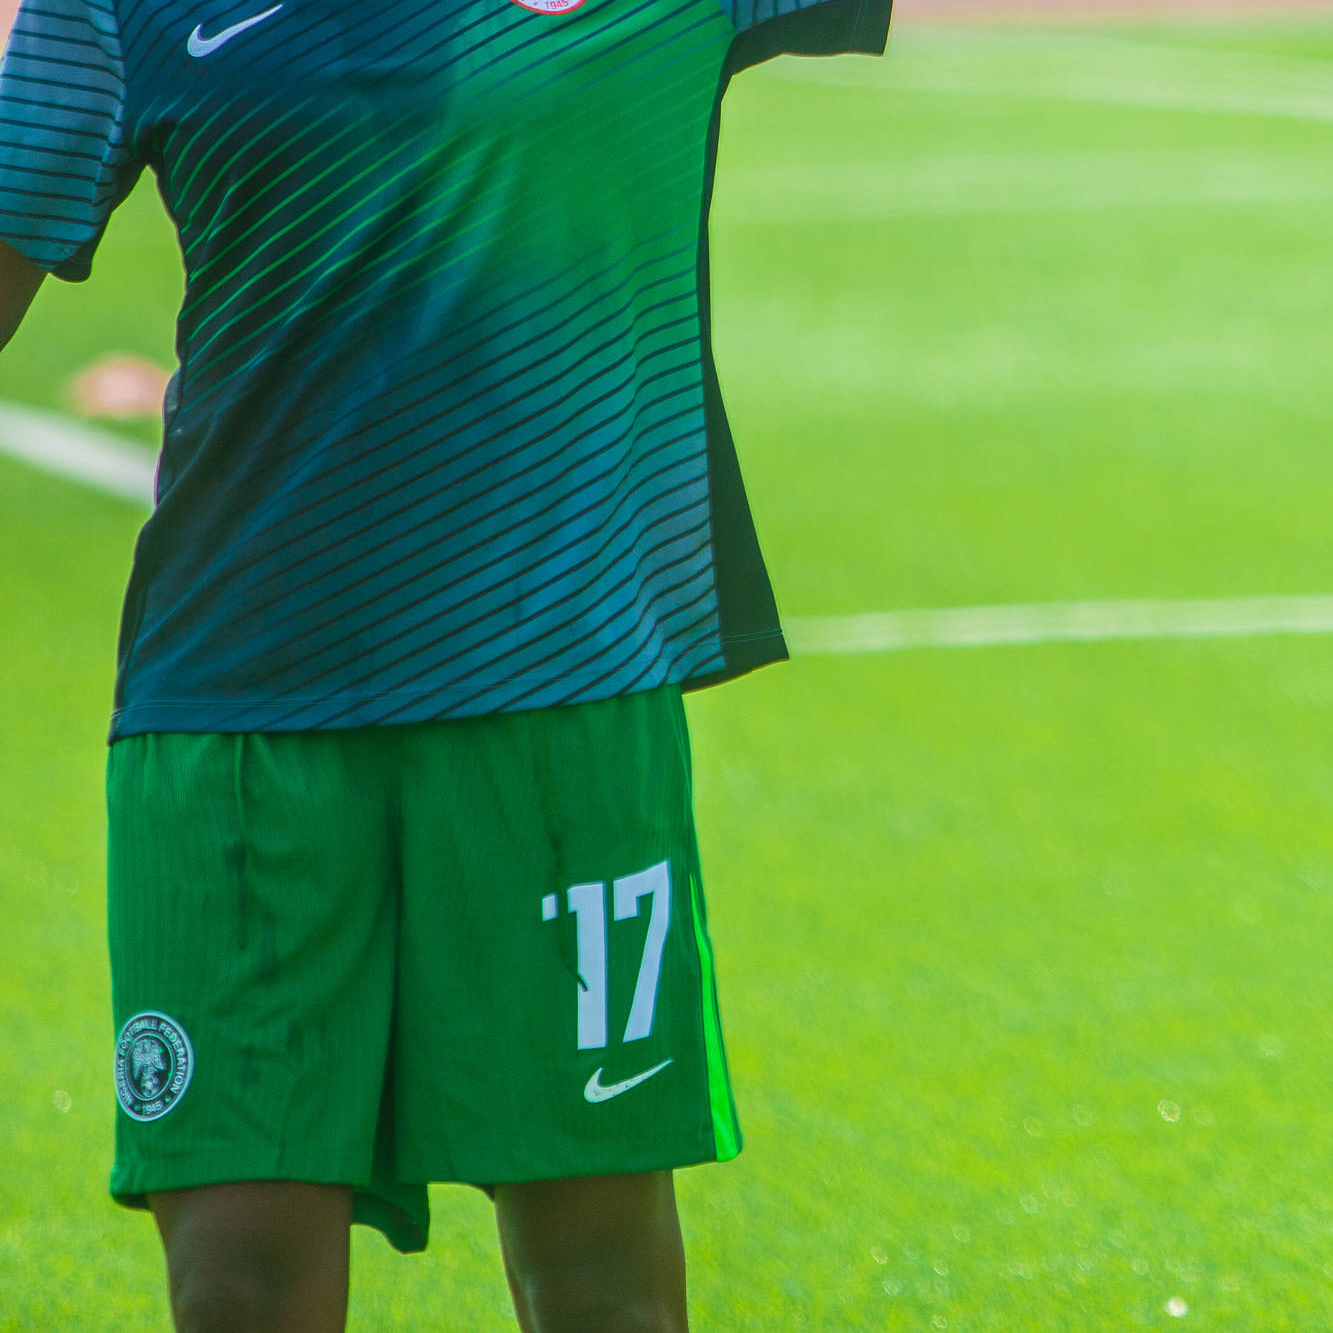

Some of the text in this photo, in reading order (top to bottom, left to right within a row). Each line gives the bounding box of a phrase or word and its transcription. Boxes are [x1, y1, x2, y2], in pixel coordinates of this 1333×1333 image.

[541, 860, 672, 1050] 17
[158, 1022, 186, 1094] FEDERATION
[142, 1101, 164, 1115] 1945
